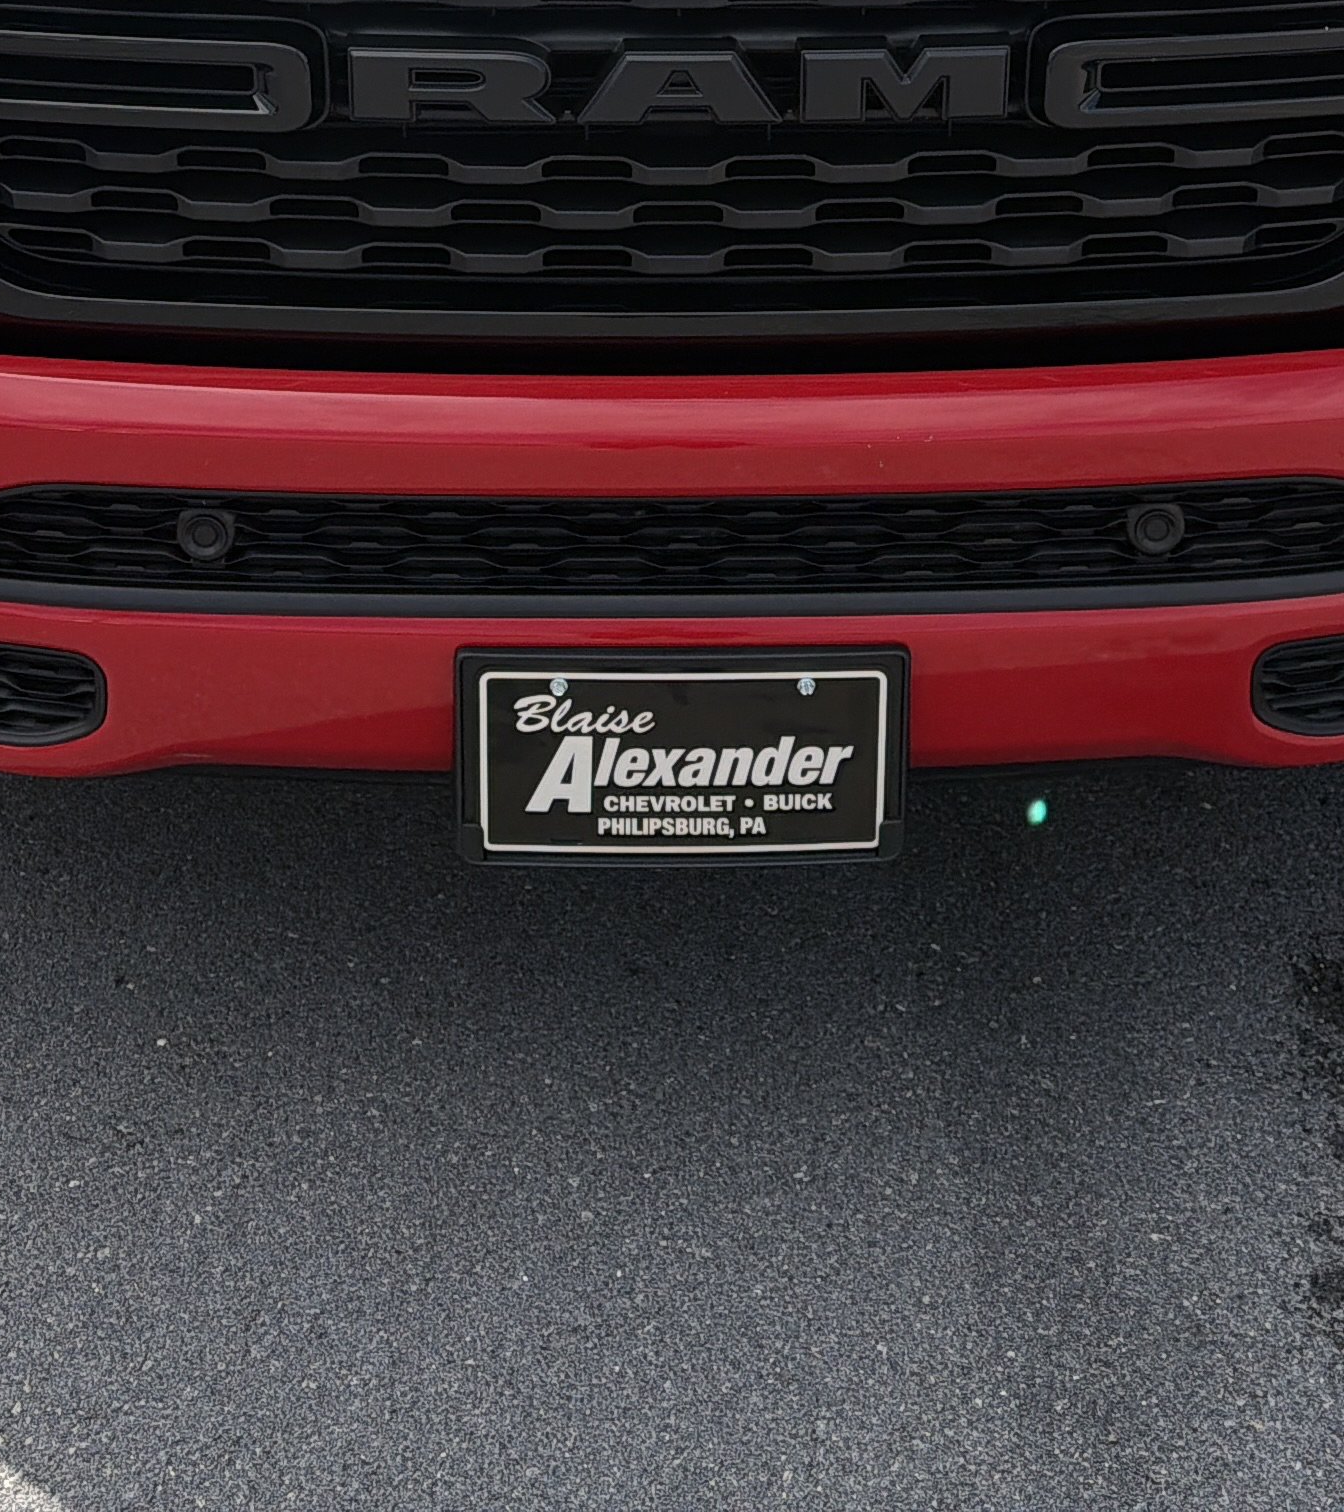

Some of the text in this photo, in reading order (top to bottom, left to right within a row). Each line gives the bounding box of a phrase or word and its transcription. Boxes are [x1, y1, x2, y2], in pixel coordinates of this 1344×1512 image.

[348, 43, 1010, 126] RAM
[513, 694, 656, 734] Blaise
[524, 734, 854, 814] Alexander
[603, 792, 833, 813] CHEVROLET BUICK
[597, 817, 766, 839] PHILIPSBURG, PA
